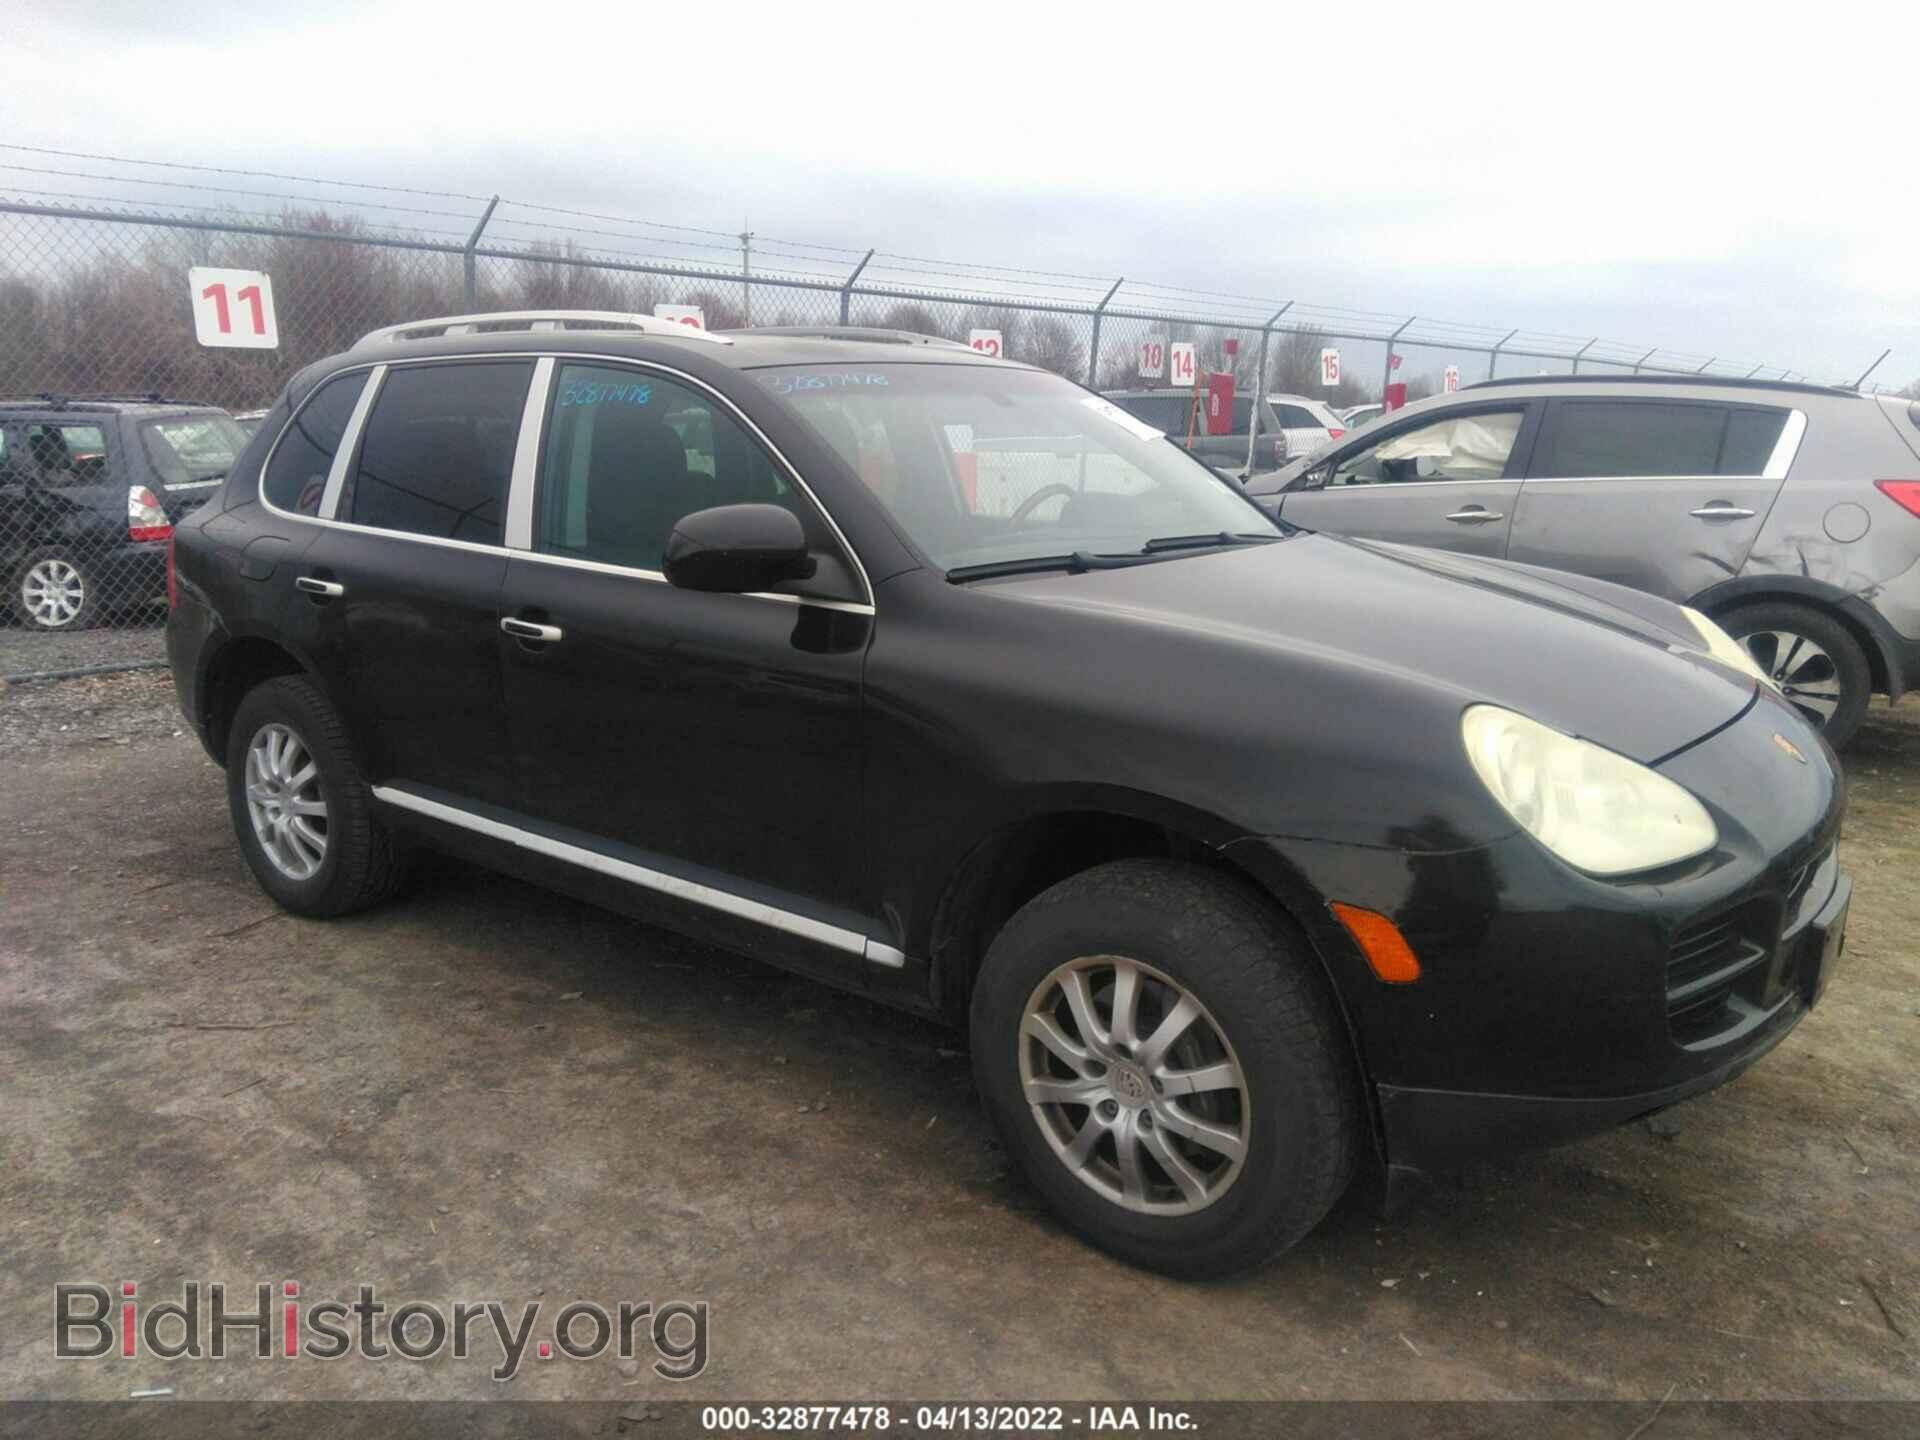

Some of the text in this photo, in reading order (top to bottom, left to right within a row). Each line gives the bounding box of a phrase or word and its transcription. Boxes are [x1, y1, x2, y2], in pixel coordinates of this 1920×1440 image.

[202, 283, 266, 335] 11
[1143, 343, 1162, 369] 10
[1173, 351, 1193, 378] 14
[1323, 355, 1338, 379] 15
